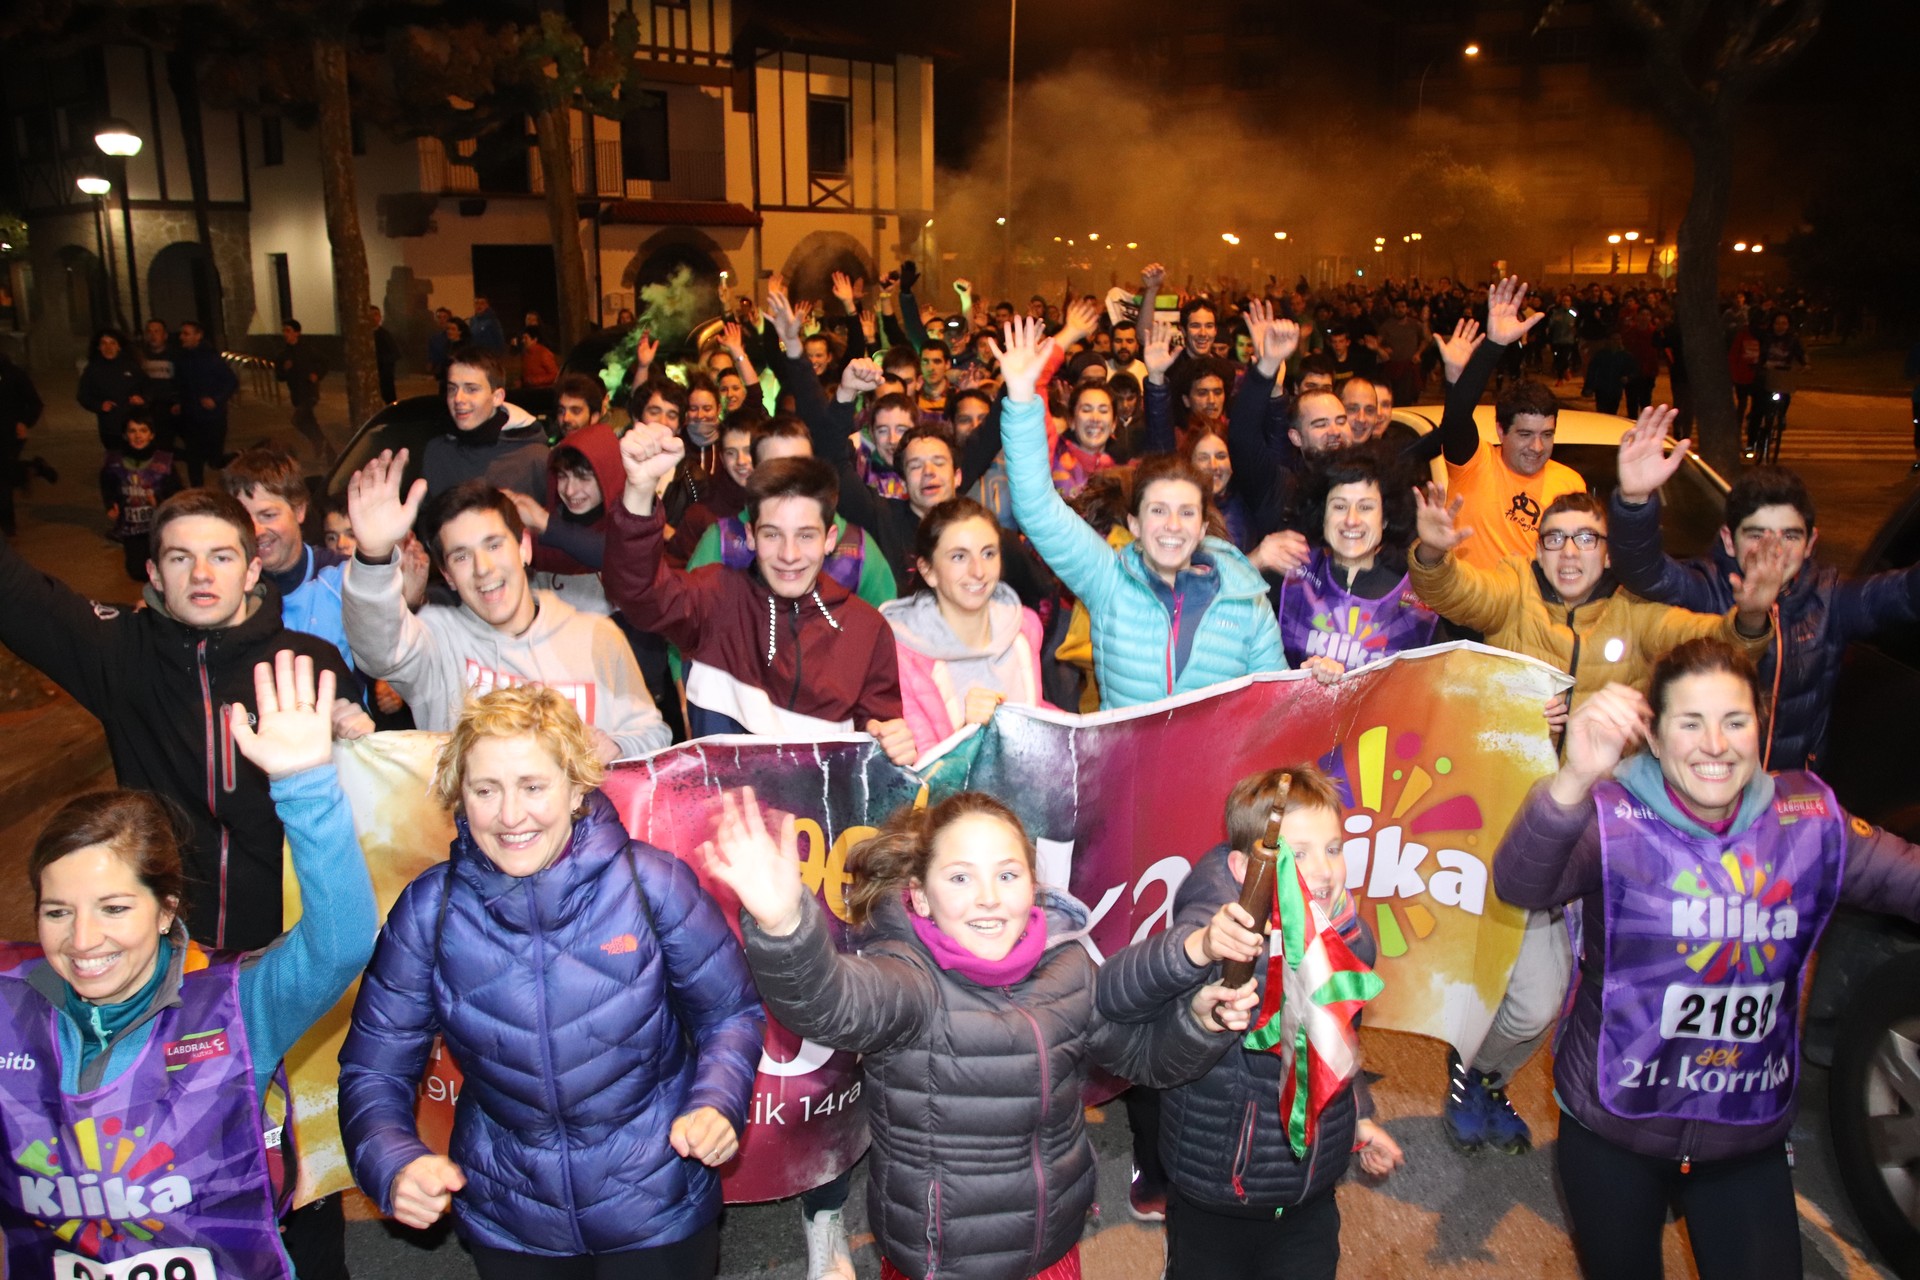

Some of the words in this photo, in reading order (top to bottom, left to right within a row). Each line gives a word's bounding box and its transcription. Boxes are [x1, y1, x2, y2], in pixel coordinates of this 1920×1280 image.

[1342, 814, 1488, 916] ika
[1671, 896, 1799, 943] Klika
[1675, 993, 1774, 1039] 2189
[167, 1041, 213, 1056] LABORAL
[1695, 1043, 1744, 1069] aek
[1617, 1058, 1671, 1088] 21.
[1677, 1050, 1790, 1094] korrika
[799, 1081, 861, 1122] 14ra
[19, 1173, 193, 1220] Klika
